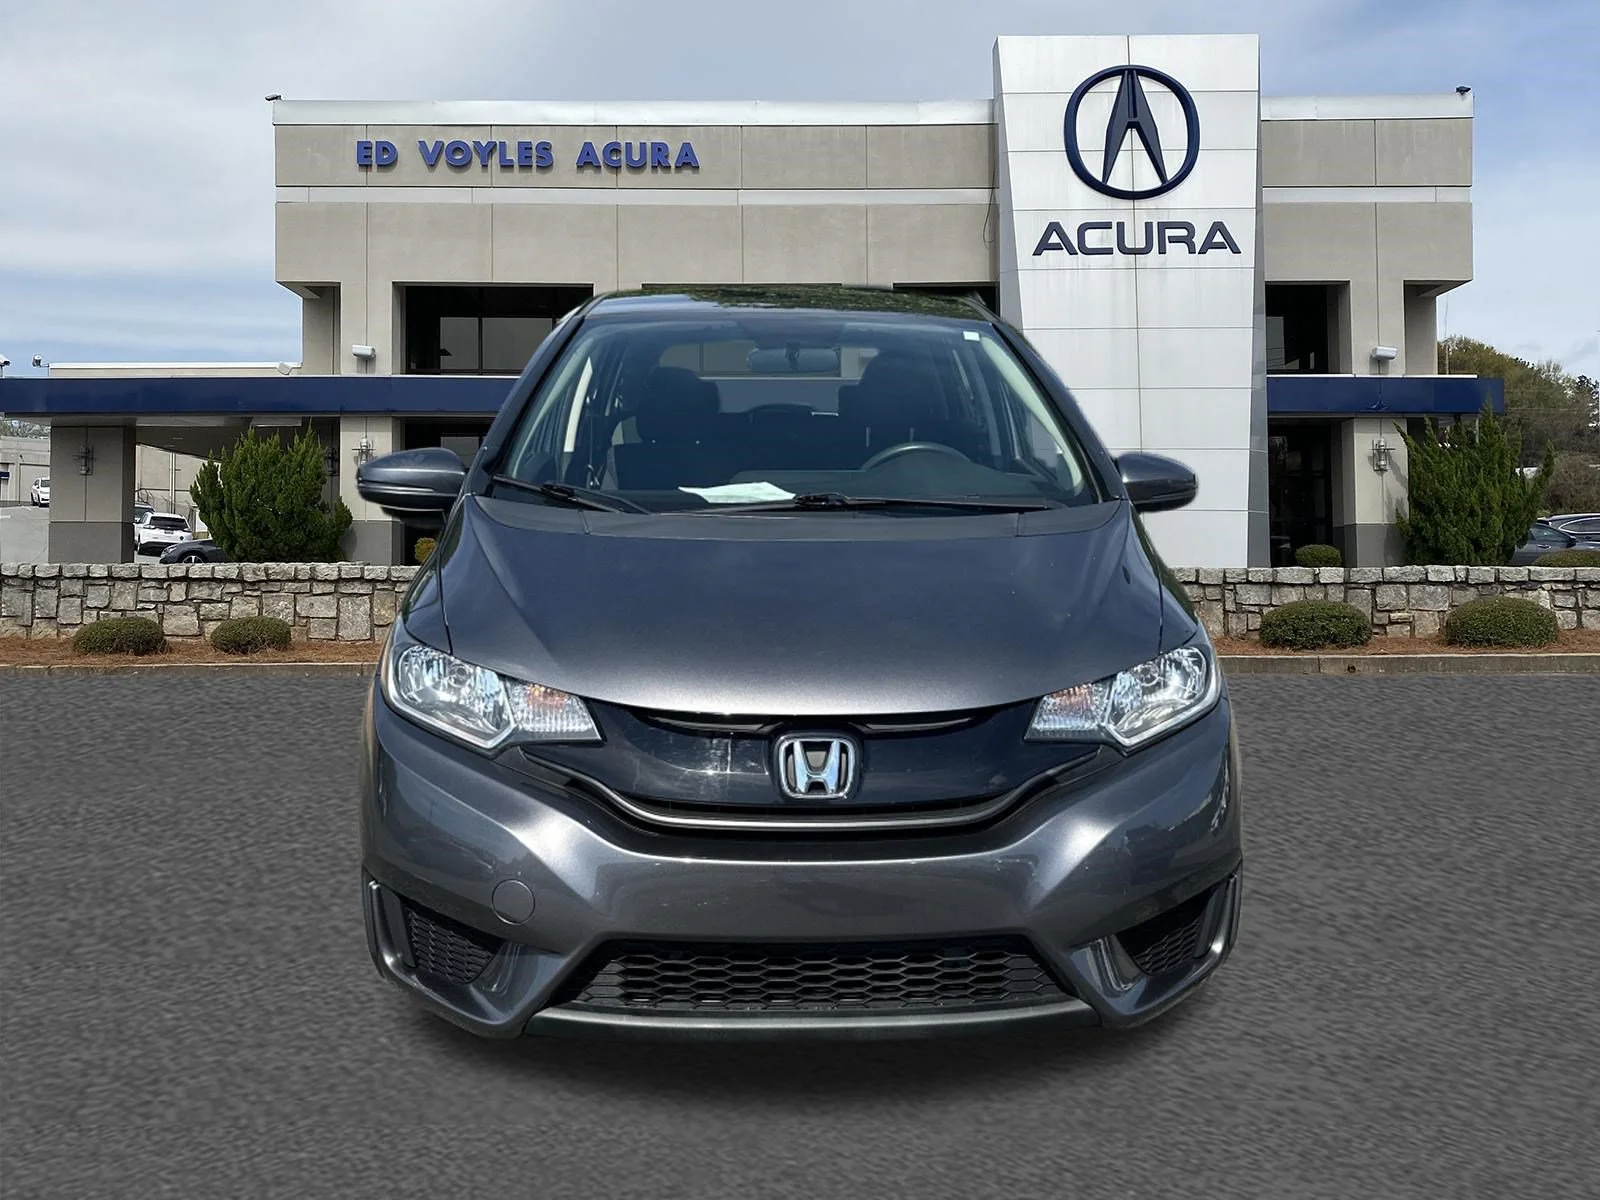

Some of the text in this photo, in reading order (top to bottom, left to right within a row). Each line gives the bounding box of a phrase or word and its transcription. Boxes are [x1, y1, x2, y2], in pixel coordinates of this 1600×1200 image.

[356, 140, 701, 170] ED VOYLES ACURA
[1033, 221, 1242, 256] ACURA
